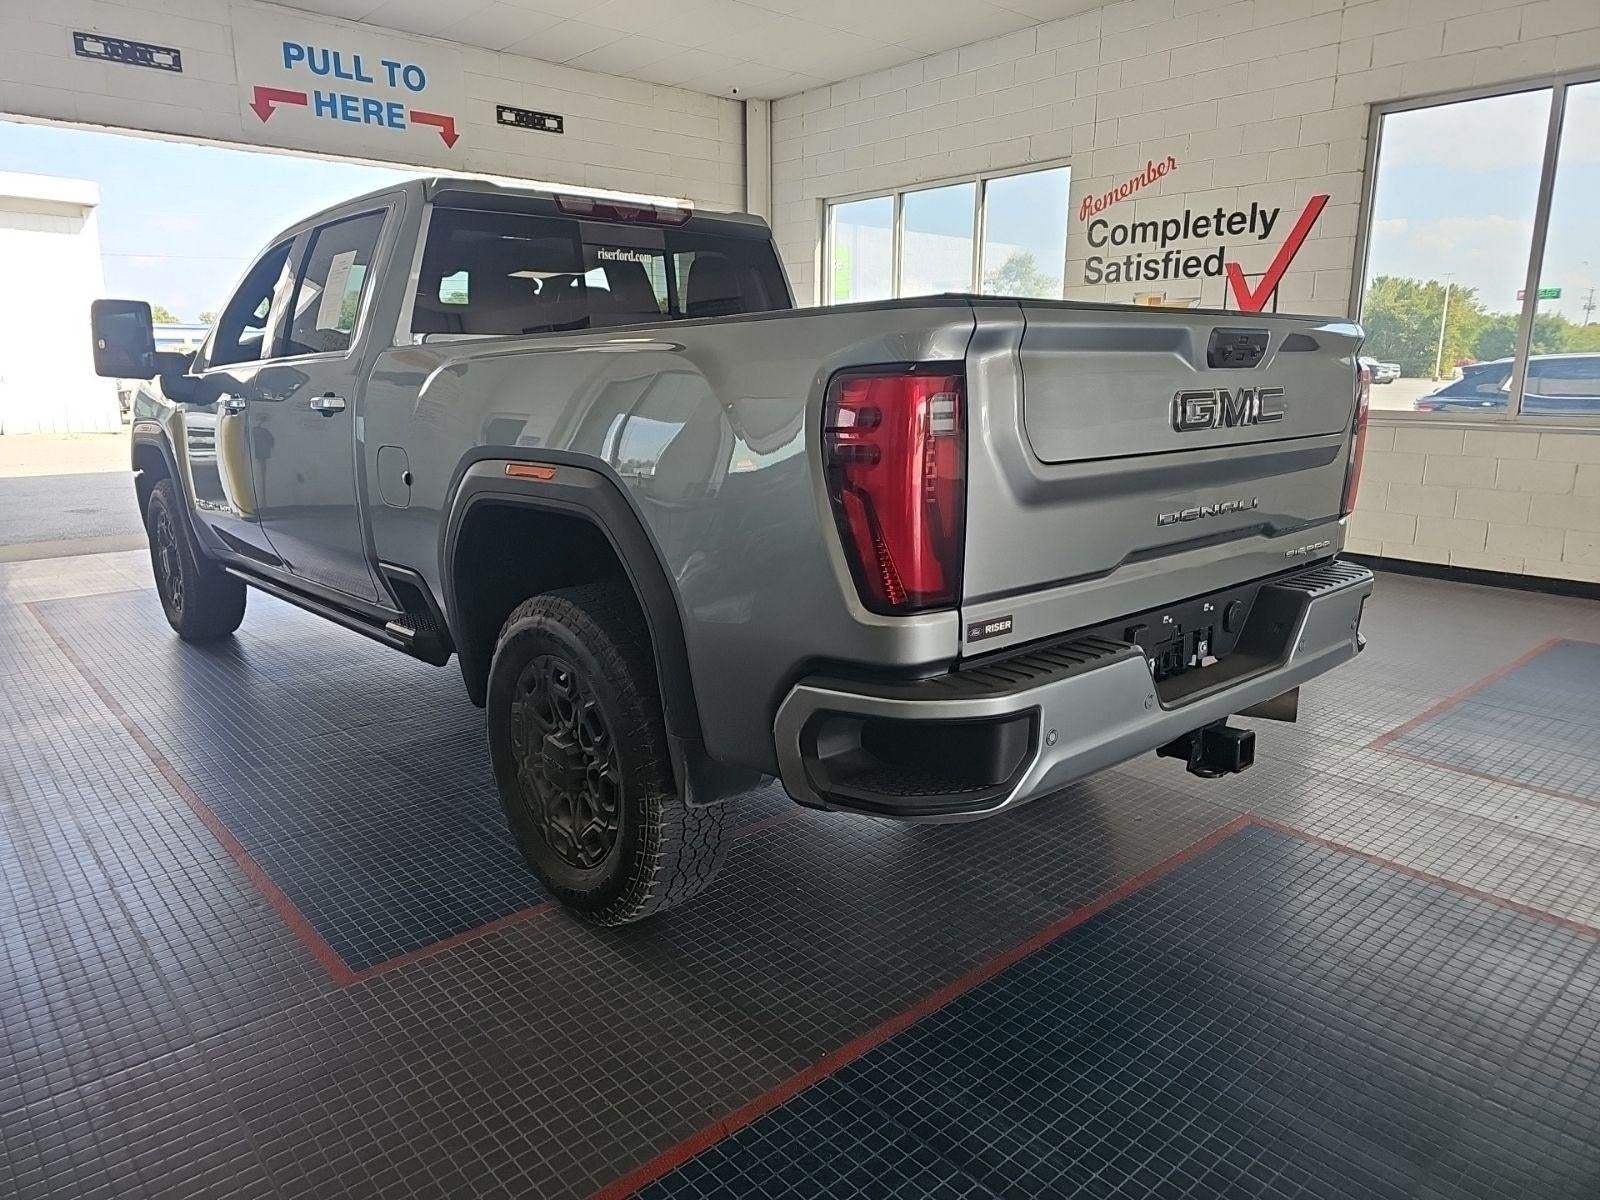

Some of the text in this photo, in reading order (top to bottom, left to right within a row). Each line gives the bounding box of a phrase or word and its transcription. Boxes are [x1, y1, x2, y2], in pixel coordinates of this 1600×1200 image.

[284, 42, 427, 93] PULL TO
[314, 91, 406, 130] HERE
[1080, 156, 1177, 221] Remember
[1087, 203, 1280, 248] Completely
[597, 248, 652, 263] riserford.com
[1085, 247, 1225, 284] Satisfied
[1172, 387, 1285, 432] GMC
[1157, 497, 1258, 526] DENALI
[985, 620, 1012, 634] RISER
